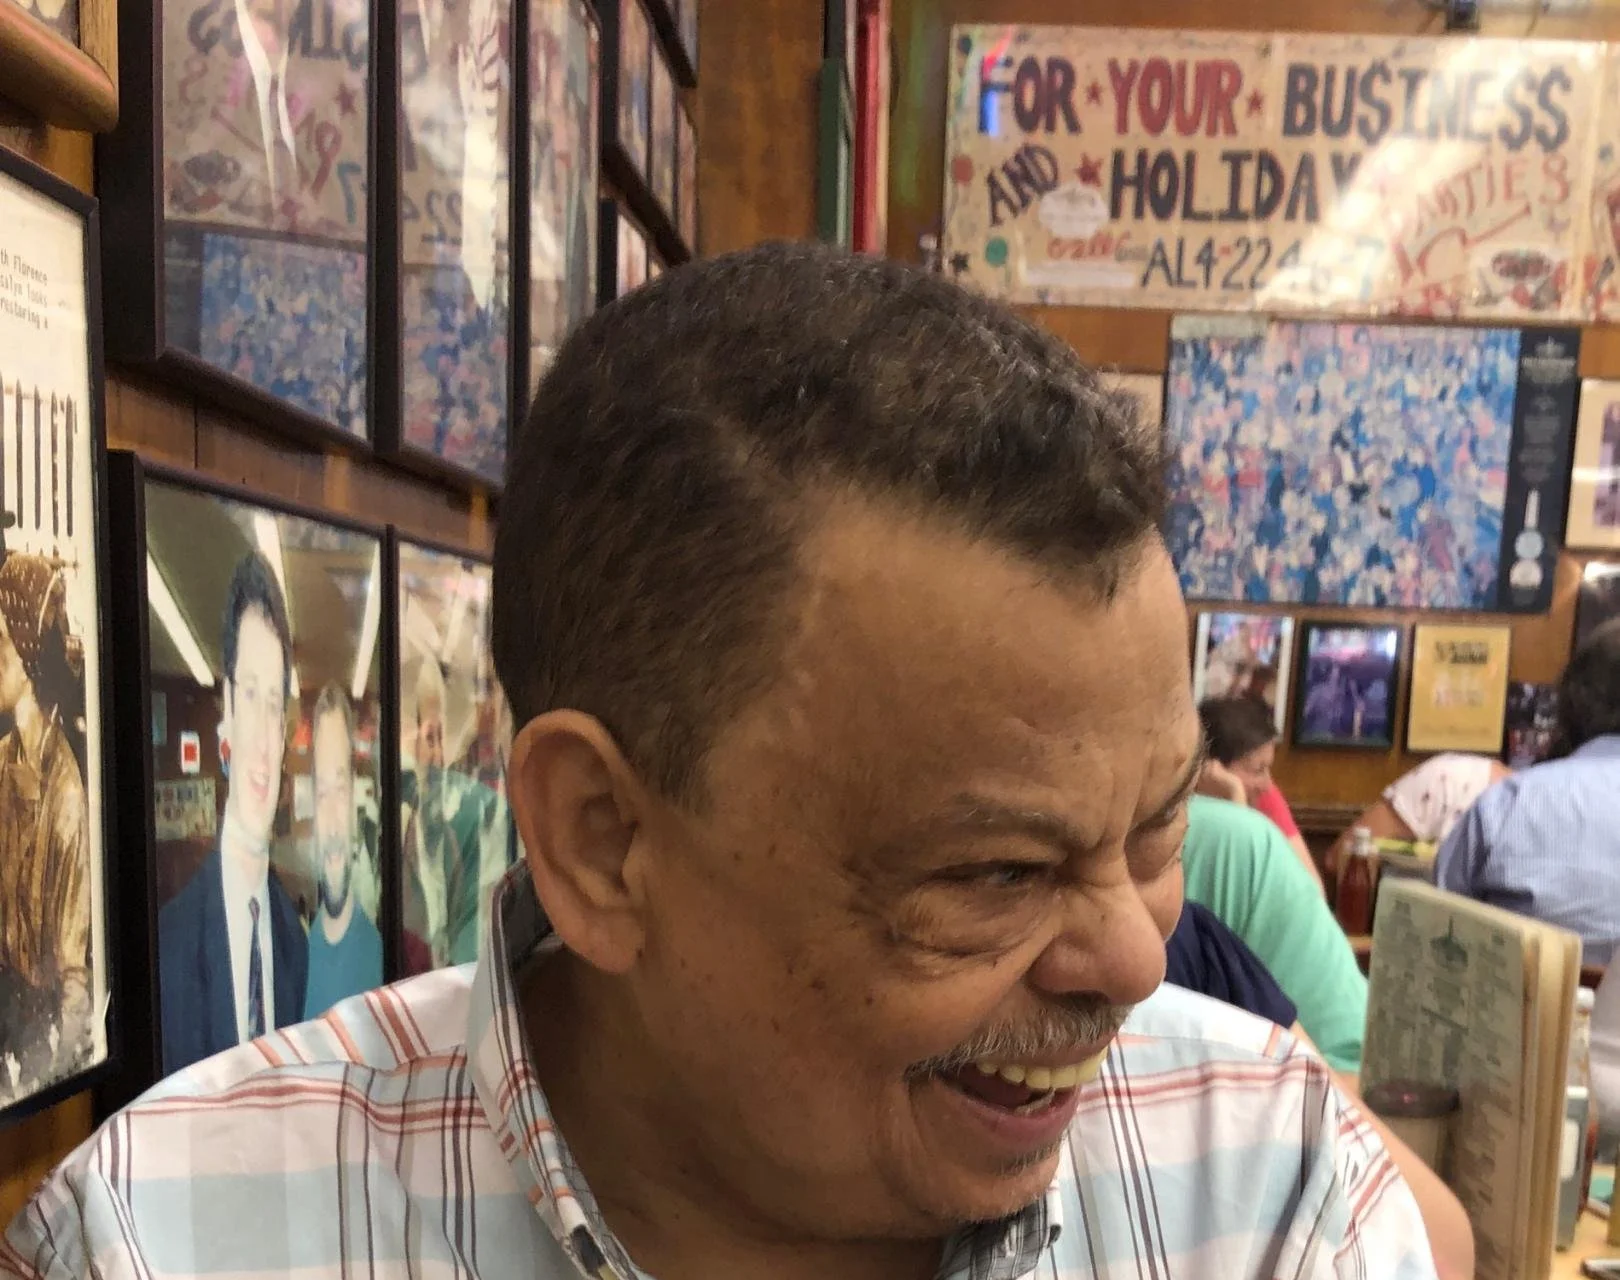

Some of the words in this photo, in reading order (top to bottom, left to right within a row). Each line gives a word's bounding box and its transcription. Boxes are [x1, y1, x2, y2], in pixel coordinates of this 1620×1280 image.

[977, 54, 1082, 135] FOR
[1107, 56, 1244, 136] YOUR
[985, 143, 1058, 226] AND
